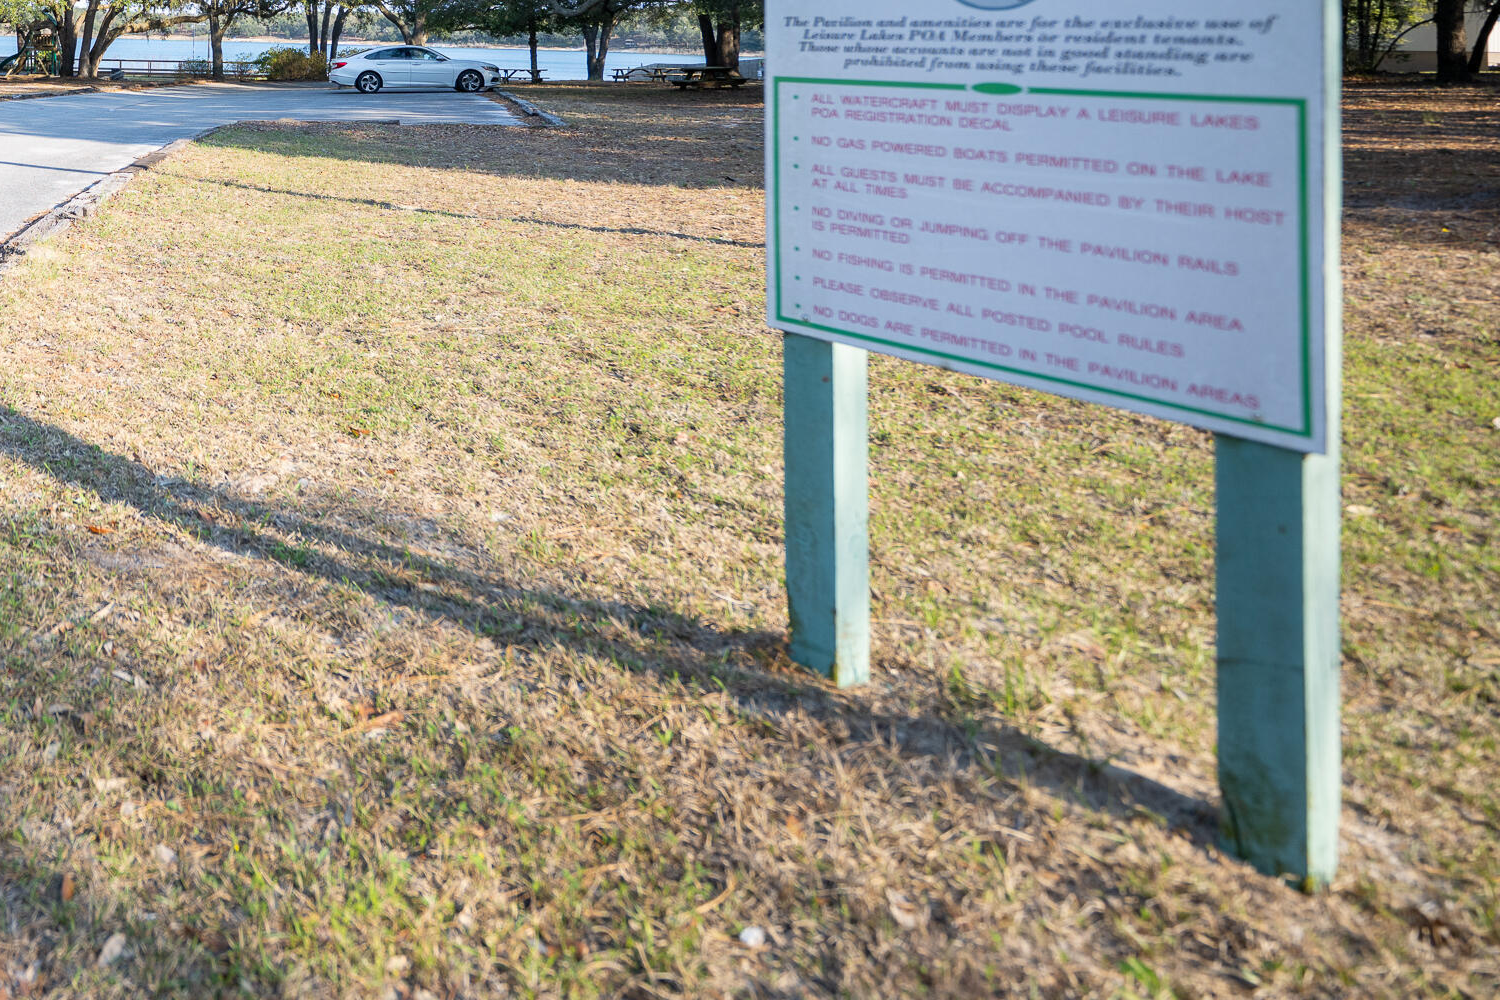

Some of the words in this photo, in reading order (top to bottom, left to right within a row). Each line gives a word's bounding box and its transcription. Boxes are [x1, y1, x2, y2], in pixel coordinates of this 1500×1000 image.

[783, 16, 808, 27] The
[813, 17, 872, 28] Pavilion
[876, 16, 907, 28] and
[909, 17, 991, 28] amenities
[996, 20, 1024, 28] are
[1029, 15, 1059, 32] for
[1064, 15, 1095, 28] the
[1100, 15, 1199, 30] exclusive
[1205, 19, 1244, 30] use
[1248, 14, 1279, 34] of
[803, 29, 855, 40] Leisure
[860, 29, 903, 41] Lakes
[909, 30, 946, 42] POA
[952, 31, 1032, 43] Members
[1037, 34, 1059, 44] or
[1064, 32, 1148, 44] resident
[798, 41, 838, 53] Those
[843, 42, 887, 54] whose
[892, 44, 963, 55] accounts
[968, 47, 996, 56] are
[1002, 46, 1032, 57] not
[1037, 47, 1055, 58] in
[1060, 46, 1110, 62] good
[1114, 47, 1209, 65] standing
[1214, 52, 1252, 61] are
[843, 56, 926, 69] prohibited
[927, 57, 972, 72] from
[976, 60, 1024, 74] using
[1029, 60, 1078, 73] these
[811, 94, 834, 105] ALL
[840, 95, 938, 110] WATERCRAFT
[944, 101, 988, 114] MUST
[996, 103, 1070, 119] DISPLAY
[1076, 108, 1091, 120] A
[1098, 108, 1181, 126] LEISURE
[1190, 113, 1261, 131] LAKES
[811, 107, 838, 119] POA
[845, 110, 953, 127] REGISTRATION
[958, 117, 1013, 132] DECAL
[811, 136, 832, 146] NO
[836, 138, 866, 149] GAS
[871, 141, 947, 157] POWERED
[953, 148, 1008, 163] BOATS
[1015, 152, 1119, 174] PERMITTED
[1126, 162, 1157, 176] ON
[1166, 165, 1206, 182] THE
[1216, 170, 1273, 187] LAKE
[811, 178, 829, 188] AT
[833, 181, 858, 193] ALL
[865, 184, 908, 199] TIMES
[811, 164, 835, 175] ALL
[840, 167, 898, 183] GUESTS
[903, 173, 946, 188] MUST
[952, 178, 975, 191] BE
[981, 182, 1112, 206] ACCOMPANIED
[1118, 196, 1145, 209] BY
[1155, 199, 1216, 218] THEIR
[1224, 208, 1287, 225] HOST
[812, 221, 825, 231] IS
[830, 223, 911, 244] PERMITTED
[812, 207, 832, 217] NO
[837, 209, 885, 225] DIVING
[890, 217, 913, 228] OR
[919, 220, 989, 241] JUMPING
[995, 231, 1029, 245] OFF
[1038, 236, 1073, 253] THE
[1080, 241, 1170, 266] PAVILION
[1178, 255, 1240, 276] RAILS
[812, 249, 832, 261] NO
[838, 253, 894, 272] FISHING
[899, 263, 914, 275] IS
[920, 266, 1011, 291] PERMITTED
[1018, 283, 1036, 296] IN
[1044, 287, 1079, 305] THE
[1086, 294, 1177, 320] PAVILION
[1185, 311, 1245, 332] AREA
[813, 276, 864, 296] PLEASE
[869, 288, 940, 311] OBSERVE
[947, 303, 975, 318] ALL
[981, 308, 1052, 332] POSTED
[1058, 322, 1109, 344] POOL
[1117, 333, 1185, 358] RULES
[813, 305, 833, 318] NO
[838, 311, 879, 328] DOGS
[884, 321, 915, 336] ARE
[921, 328, 1013, 356] PERMITTED
[1018, 349, 1037, 361] IN
[1044, 353, 1079, 372] THE
[1087, 361, 1178, 391] PAVILION
[1186, 383, 1261, 410] AREAS
